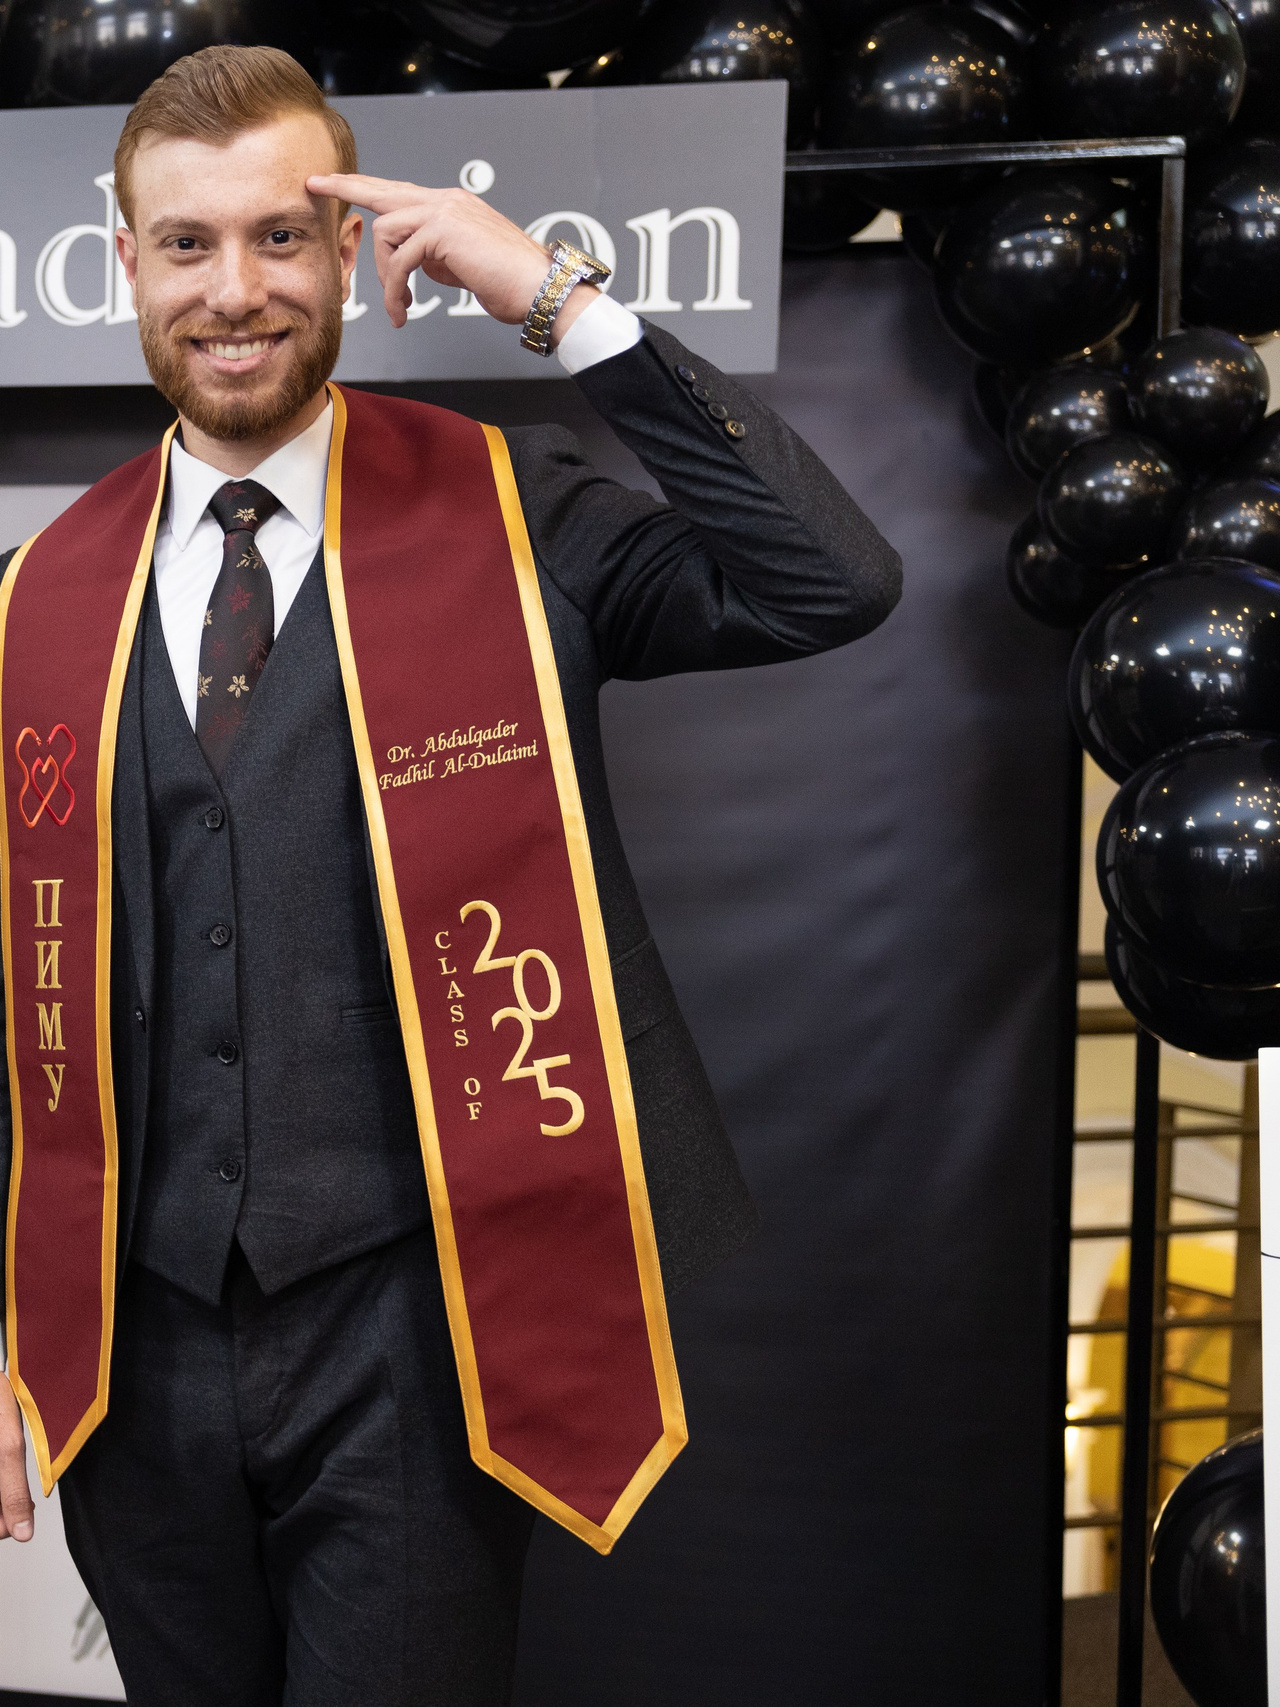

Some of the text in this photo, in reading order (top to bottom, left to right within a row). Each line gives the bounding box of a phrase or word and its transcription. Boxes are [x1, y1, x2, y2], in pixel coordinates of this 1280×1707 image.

[379, 739, 538, 790] Fadhil Al-Dulaimi
[387, 719, 518, 763] Dr. Abdulqader
[31, 878, 66, 1112] ПИМУ
[434, 930, 482, 1120] CLASS OF
[459, 900, 585, 1137] 2025
